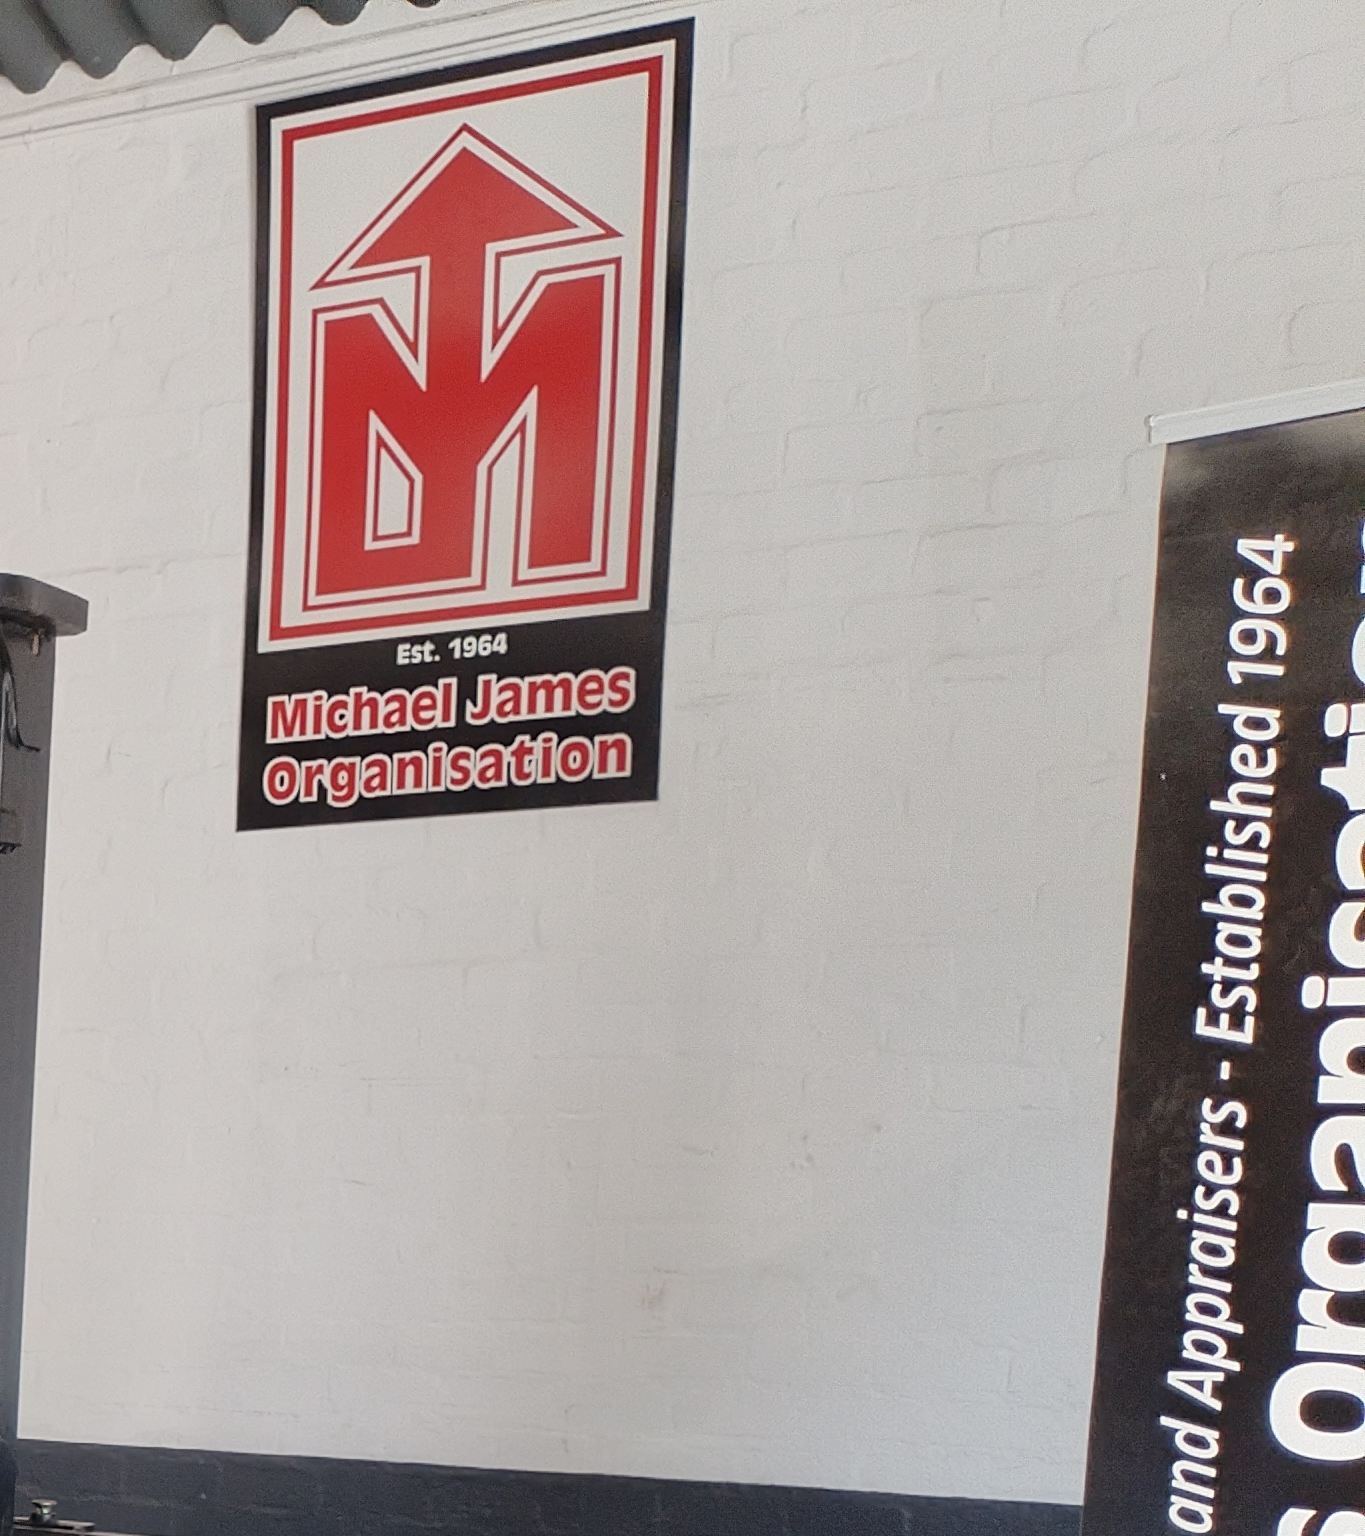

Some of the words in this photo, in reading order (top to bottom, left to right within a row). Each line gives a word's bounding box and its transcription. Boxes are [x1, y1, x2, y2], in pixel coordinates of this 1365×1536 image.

[397, 641, 440, 665] Est.
[448, 632, 508, 659] 1964
[1227, 533, 1295, 685] 1964
[266, 677, 457, 744] Michael
[465, 665, 636, 725] James
[262, 732, 632, 808] Organisation
[1195, 703, 1282, 1045] Established
[1166, 1097, 1248, 1412] Appraisers
[1159, 1415, 1220, 1534] and
